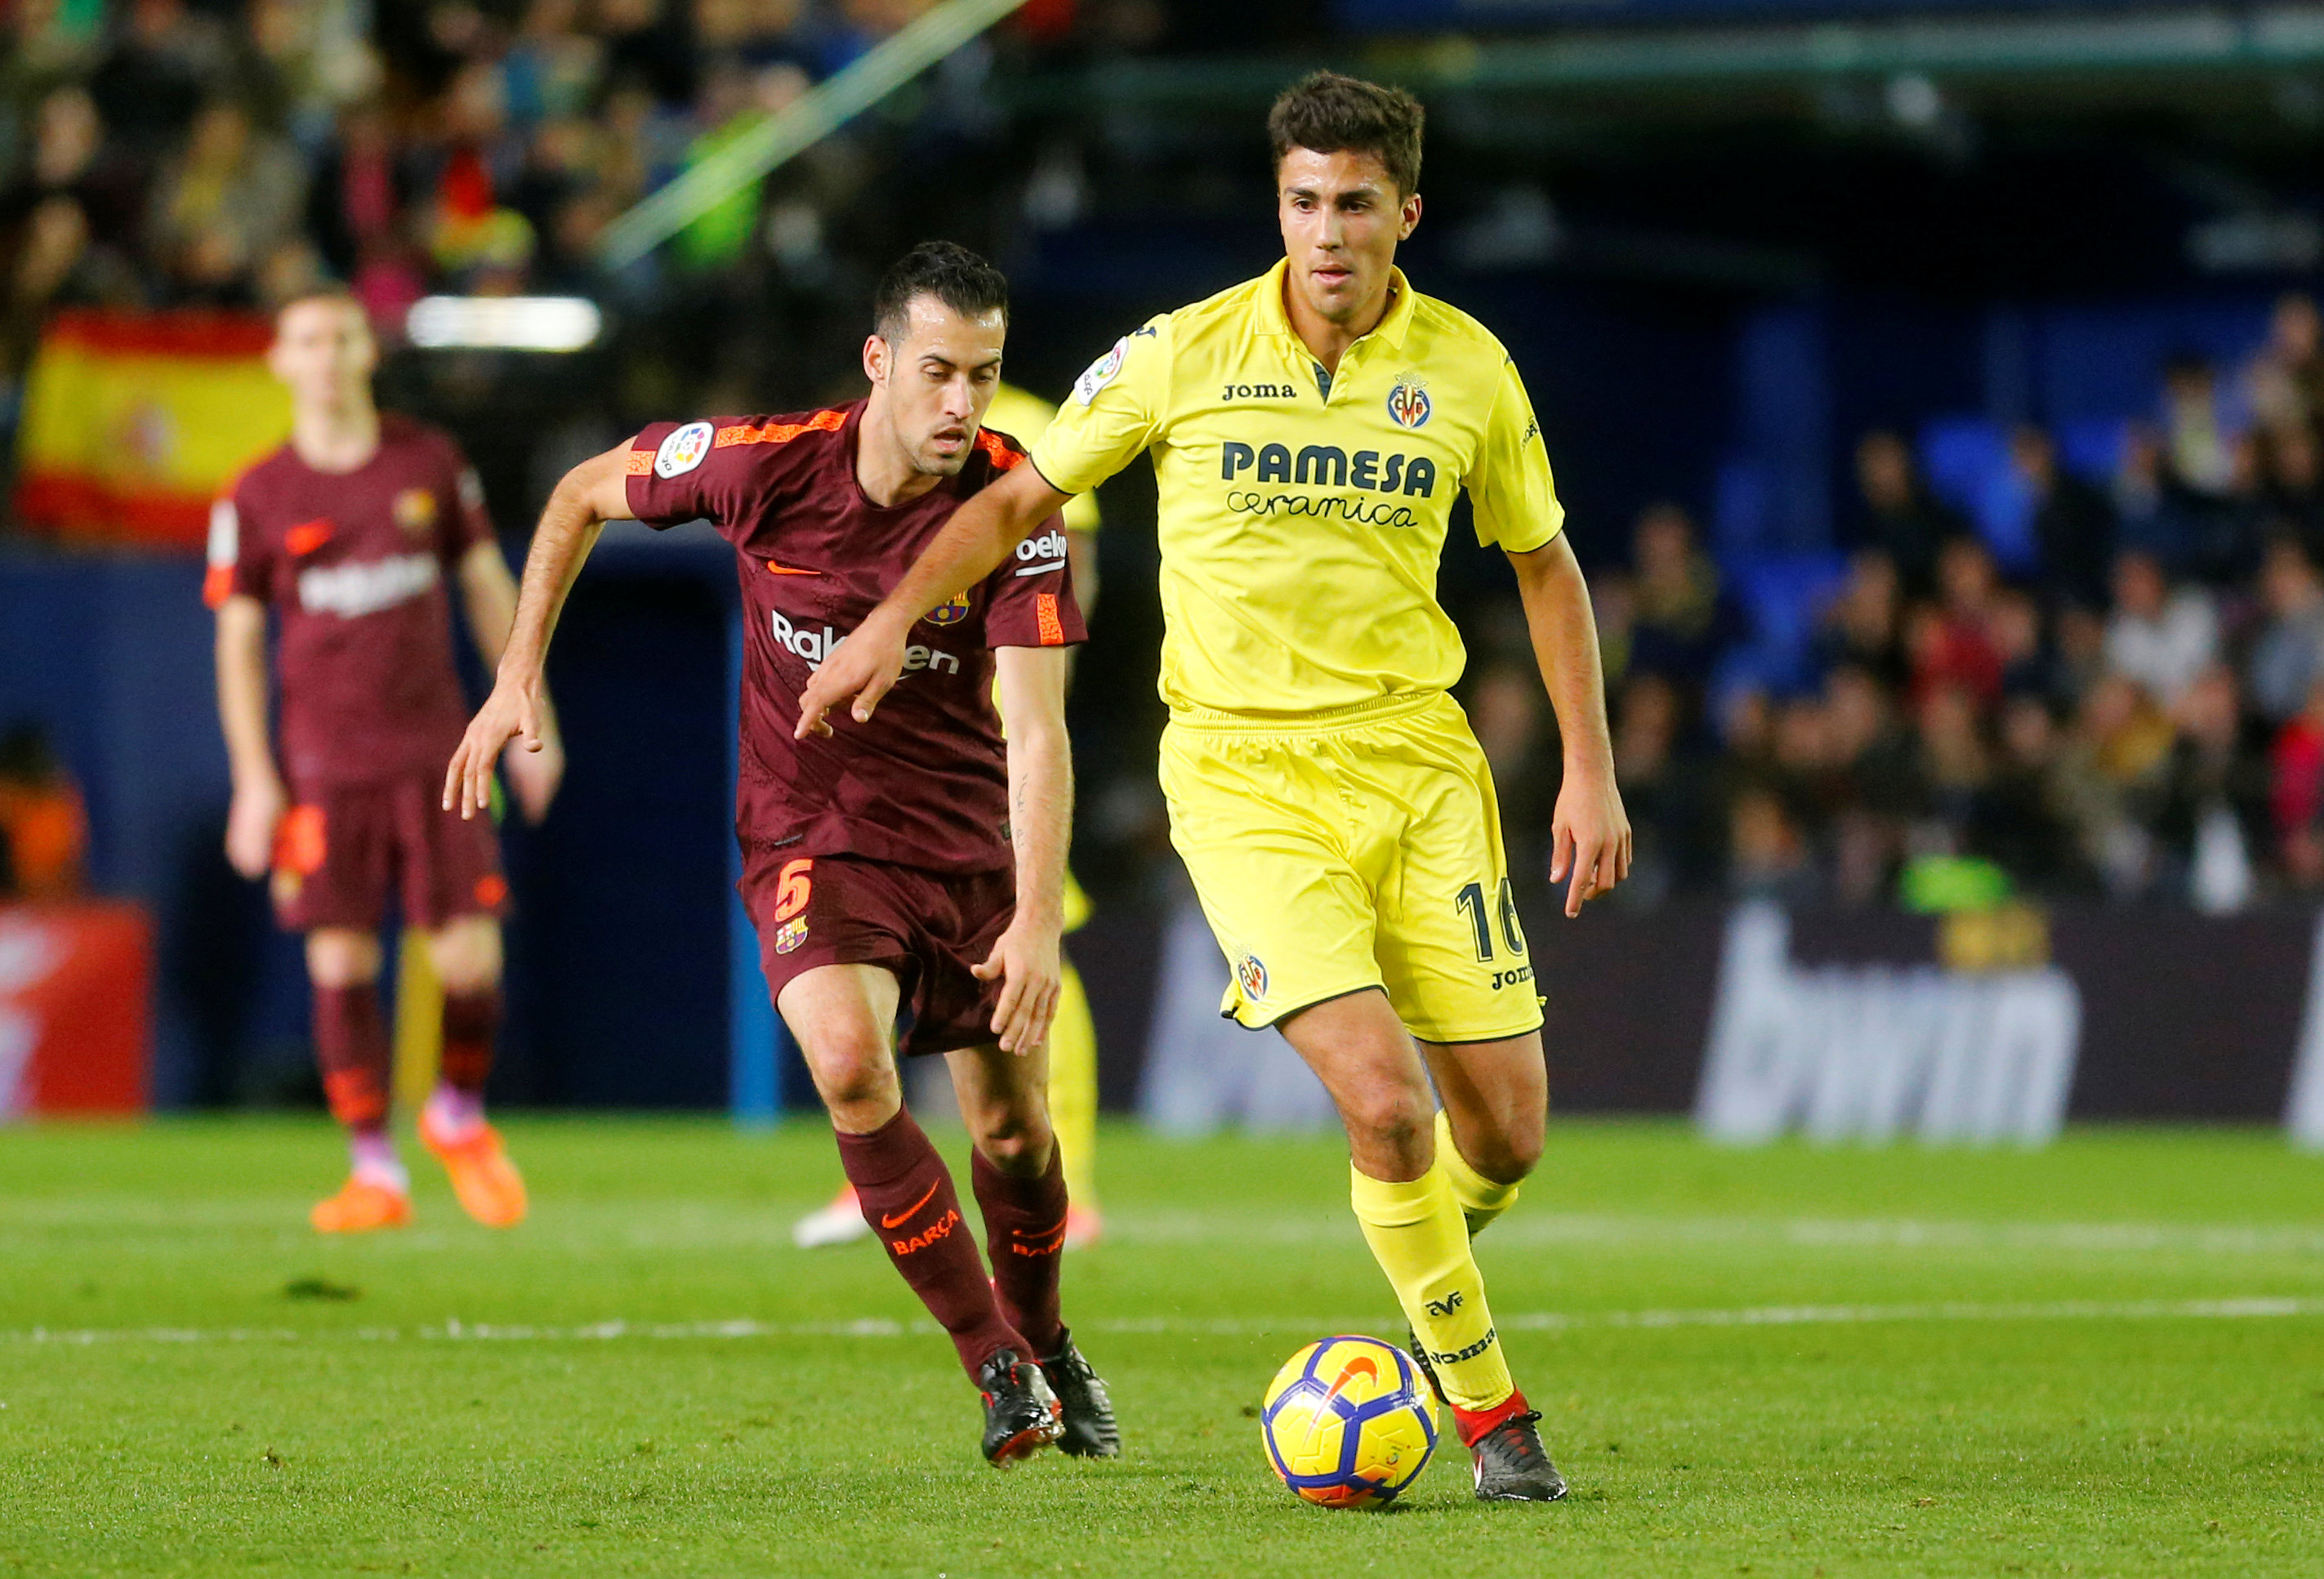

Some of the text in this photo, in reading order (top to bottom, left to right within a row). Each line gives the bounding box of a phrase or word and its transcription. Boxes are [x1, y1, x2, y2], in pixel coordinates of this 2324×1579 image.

[1222, 441, 1436, 498] PAMESA
[1227, 491, 1418, 528] ceramica
[774, 859, 814, 922] 5
[1455, 876, 1524, 963] 16
[892, 1209, 960, 1256] BARÇA
